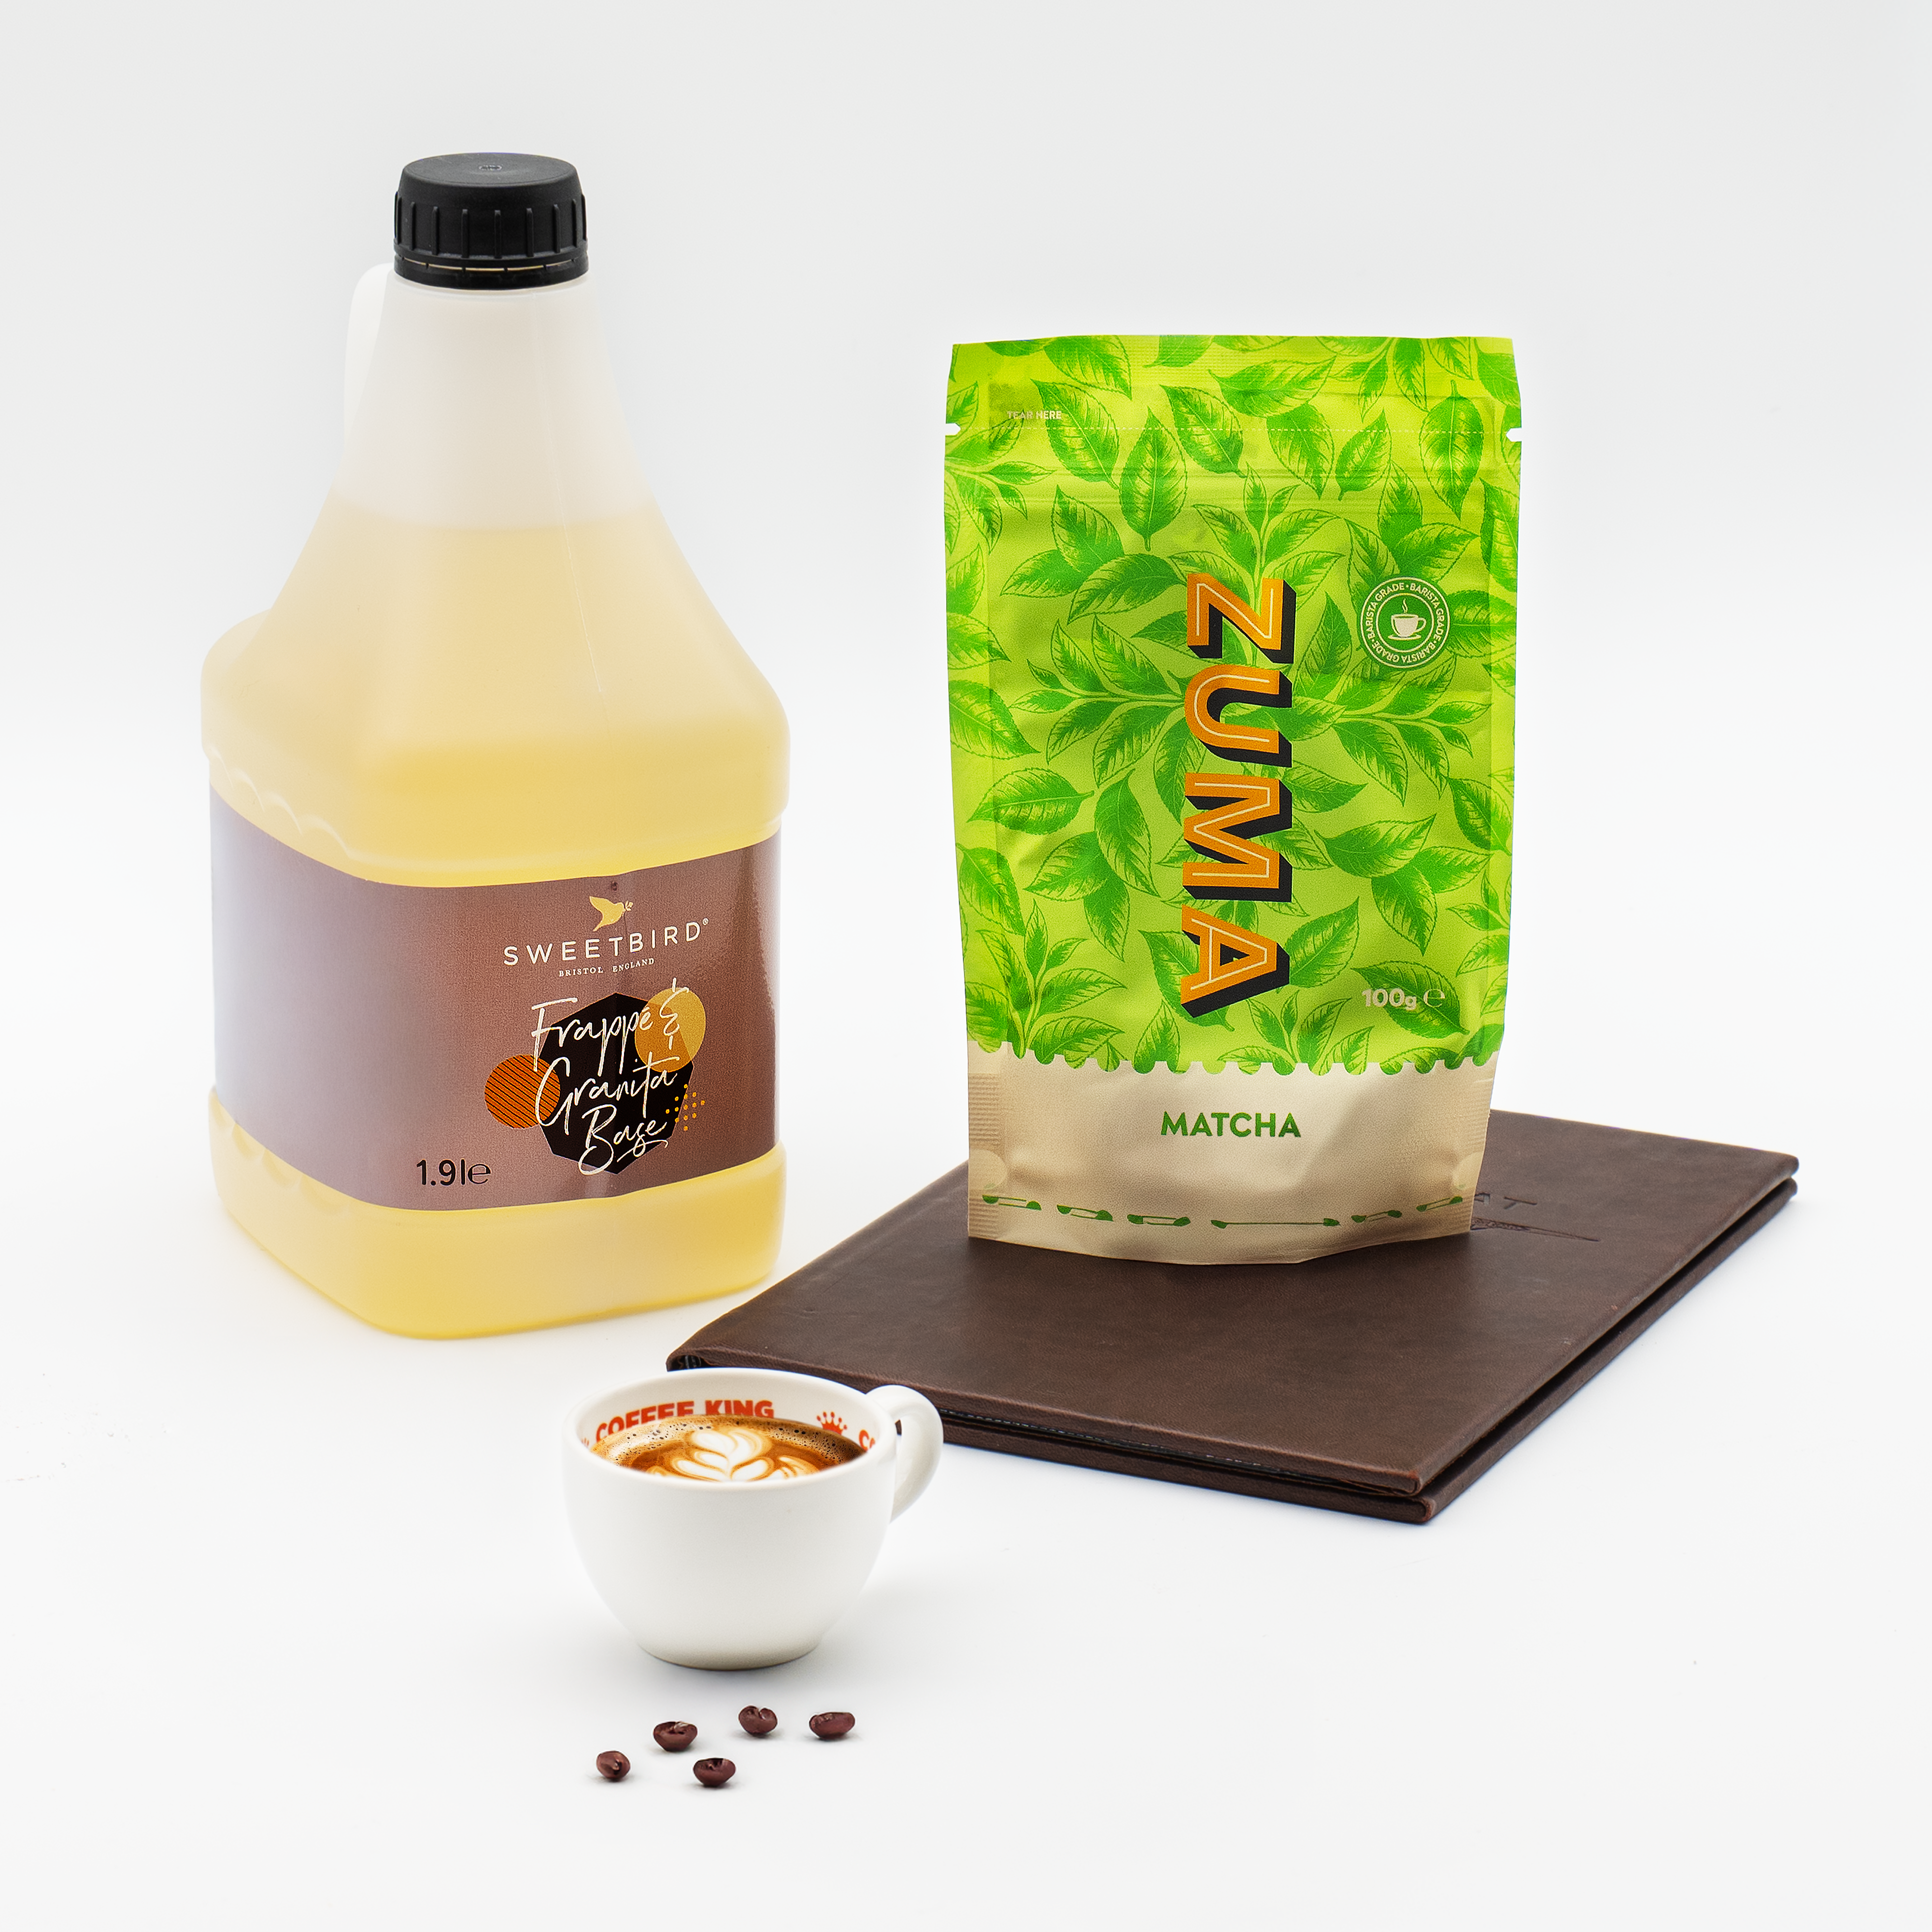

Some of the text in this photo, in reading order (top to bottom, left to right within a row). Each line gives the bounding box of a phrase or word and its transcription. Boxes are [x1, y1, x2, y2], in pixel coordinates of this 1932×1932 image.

[1007, 410, 1062, 420] TEAR HERE
[1365, 582, 1405, 639] BARISTA GRADE
[1410, 582, 1445, 641] BARISTA GRADE
[1372, 640, 1436, 663] BARISTA GRADE
[1180, 572, 1297, 1018] ZUMA
[559, 958, 655, 977] BRISTOL ENGLAND
[1362, 988, 1417, 1010] 100g
[531, 978, 689, 1077] Frappé &
[535, 1051, 680, 1135] Granita
[579, 1104, 668, 1175] Base
[1161, 1111, 1301, 1137] MATCHA
[705, 1400, 774, 1419] KING
